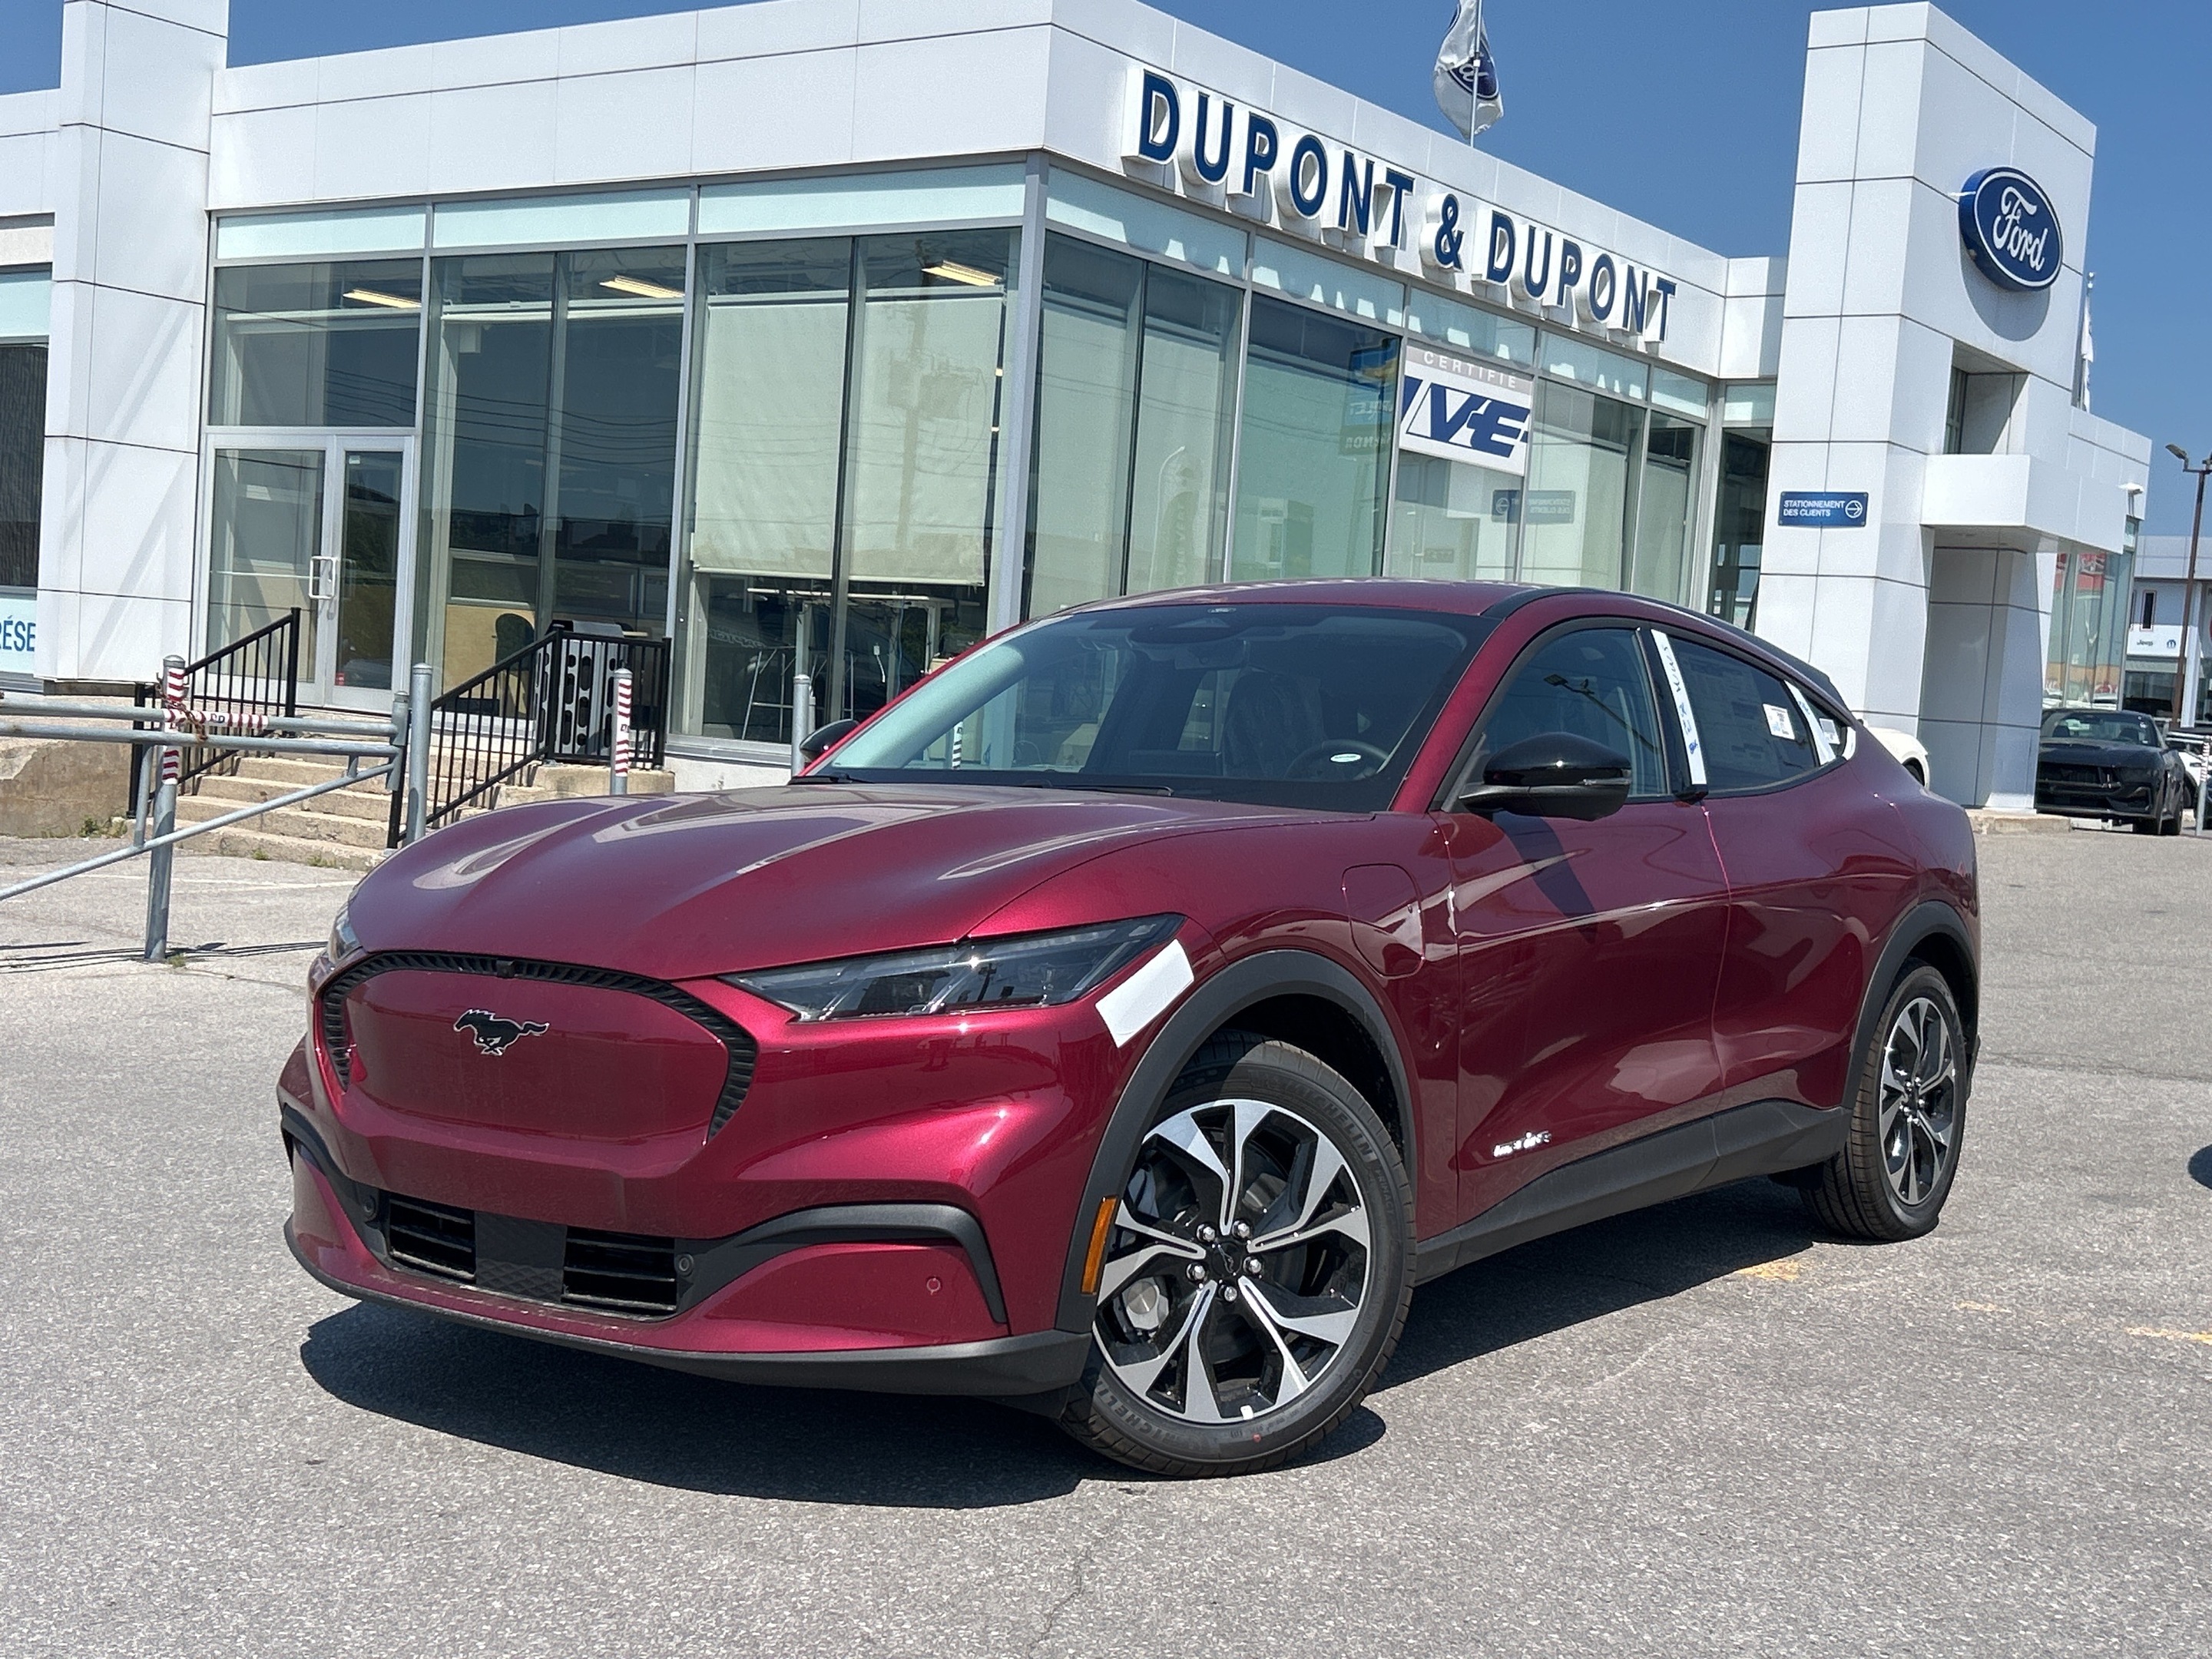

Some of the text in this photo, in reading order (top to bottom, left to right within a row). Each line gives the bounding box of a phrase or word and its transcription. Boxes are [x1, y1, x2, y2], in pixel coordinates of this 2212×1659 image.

[1140, 70, 1676, 343] DUPONT & DUPONT
[1992, 186, 2048, 271] Ford
[1783, 500, 1846, 508] STATIONNEMENT
[1783, 508, 1831, 517] DES CLIENTS
[1286, 1078, 1375, 1157] MICHELIN
